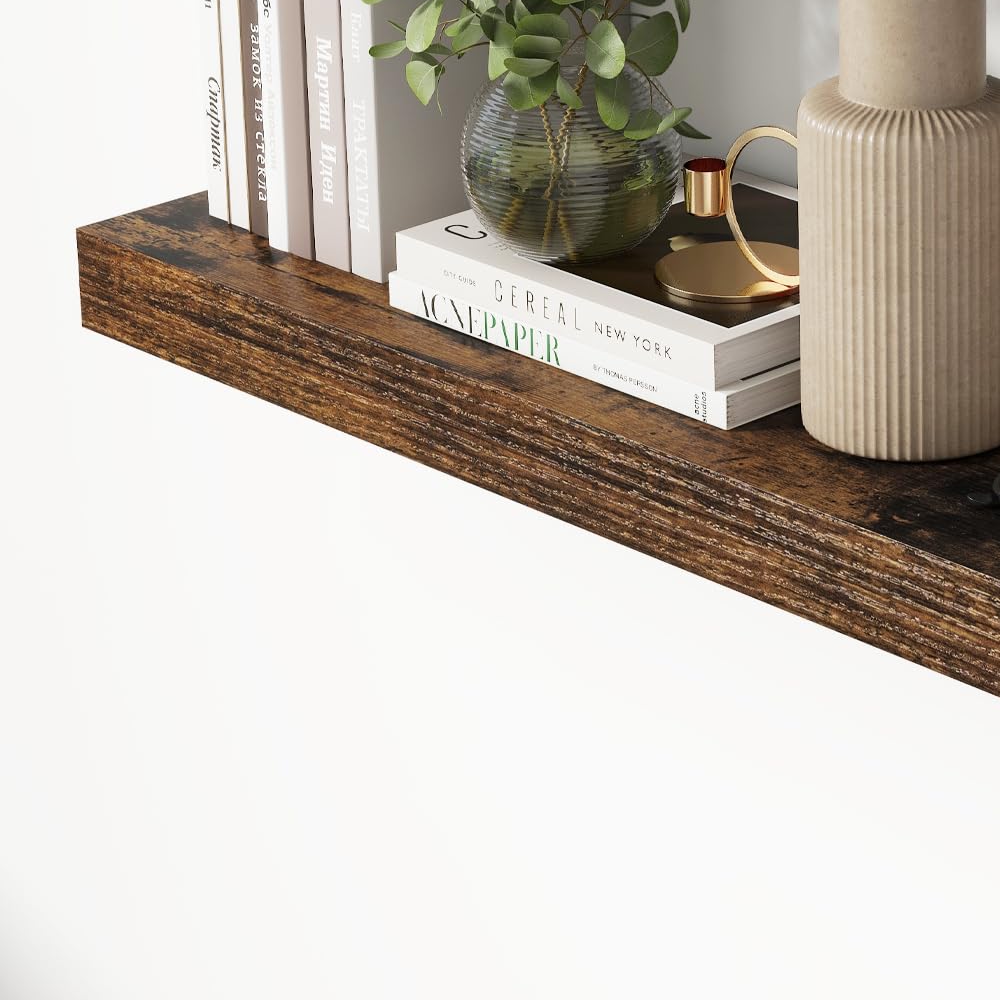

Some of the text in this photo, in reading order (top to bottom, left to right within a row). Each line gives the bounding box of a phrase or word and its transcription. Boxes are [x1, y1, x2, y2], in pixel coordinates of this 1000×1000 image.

[206, 76, 222, 172] Спартак
[315, 35, 337, 207] Мартин Иден
[458, 275, 477, 287] GUIDE
[494, 279, 581, 332] CEREAL
[594, 320, 627, 342] NEW
[633, 335, 672, 360] YORK
